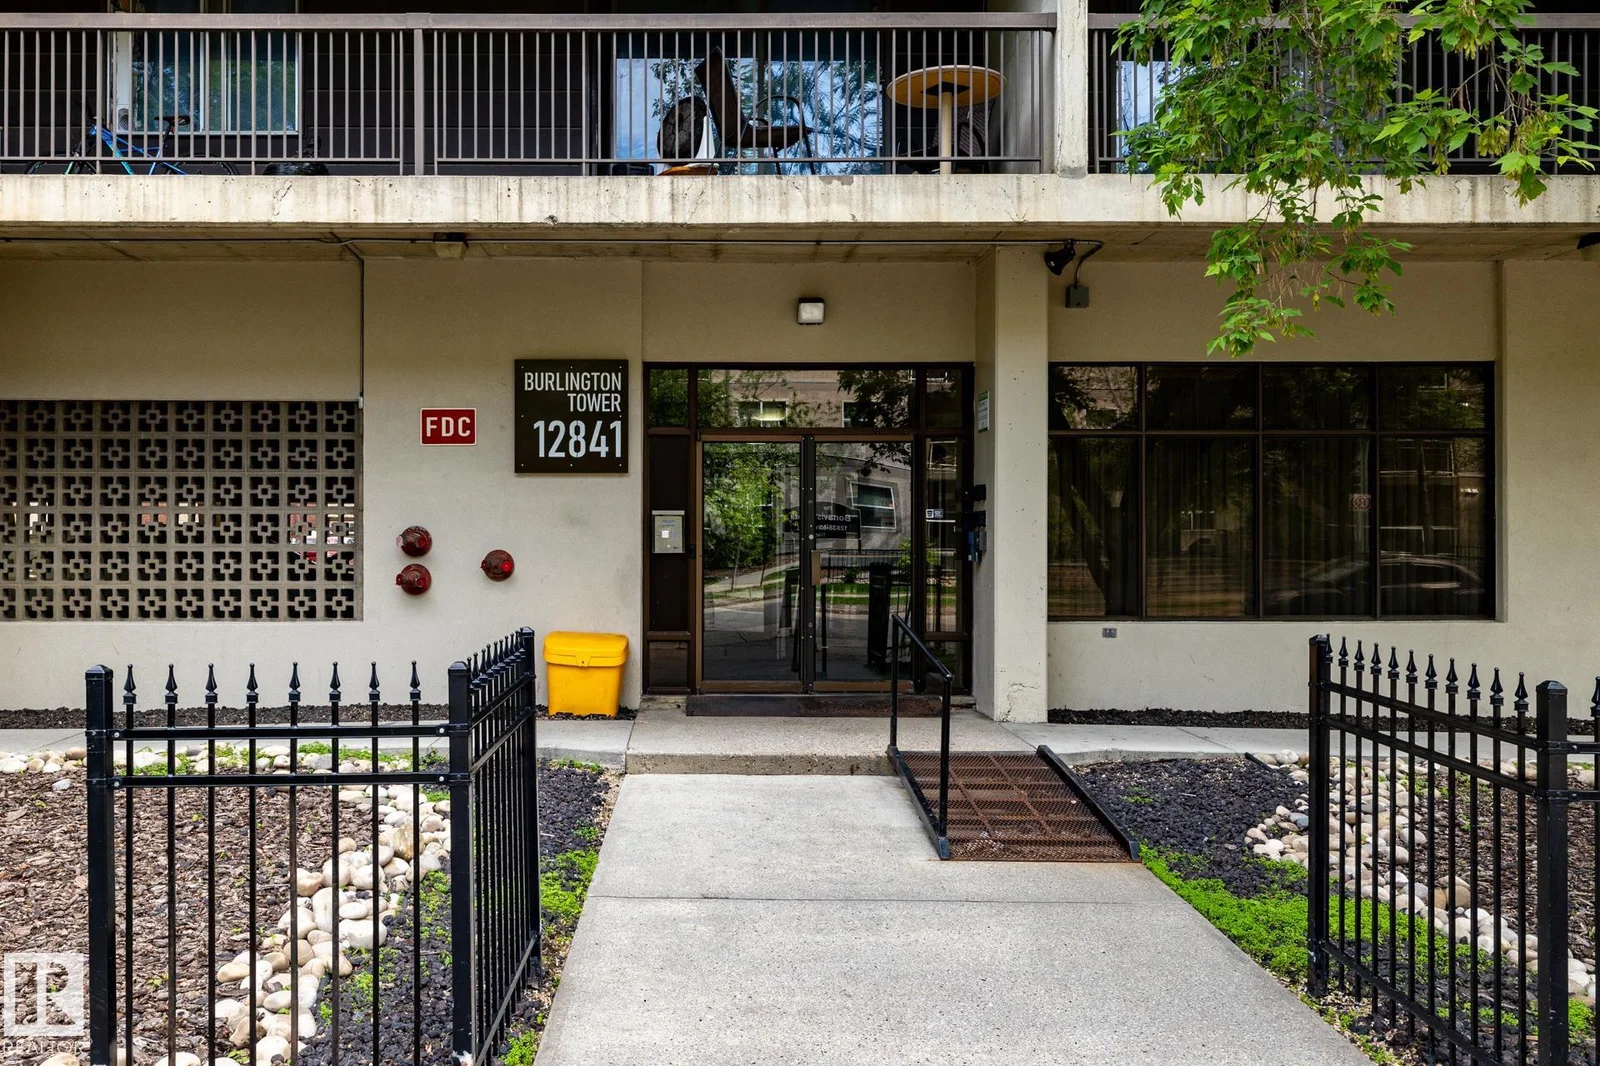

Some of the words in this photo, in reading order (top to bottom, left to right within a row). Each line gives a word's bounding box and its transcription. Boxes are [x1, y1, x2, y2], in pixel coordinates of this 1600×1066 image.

[524, 372, 622, 391] BURLINGTON
[567, 393, 622, 412] TOWER
[426, 416, 471, 437] FDC
[533, 420, 622, 458] 12841
